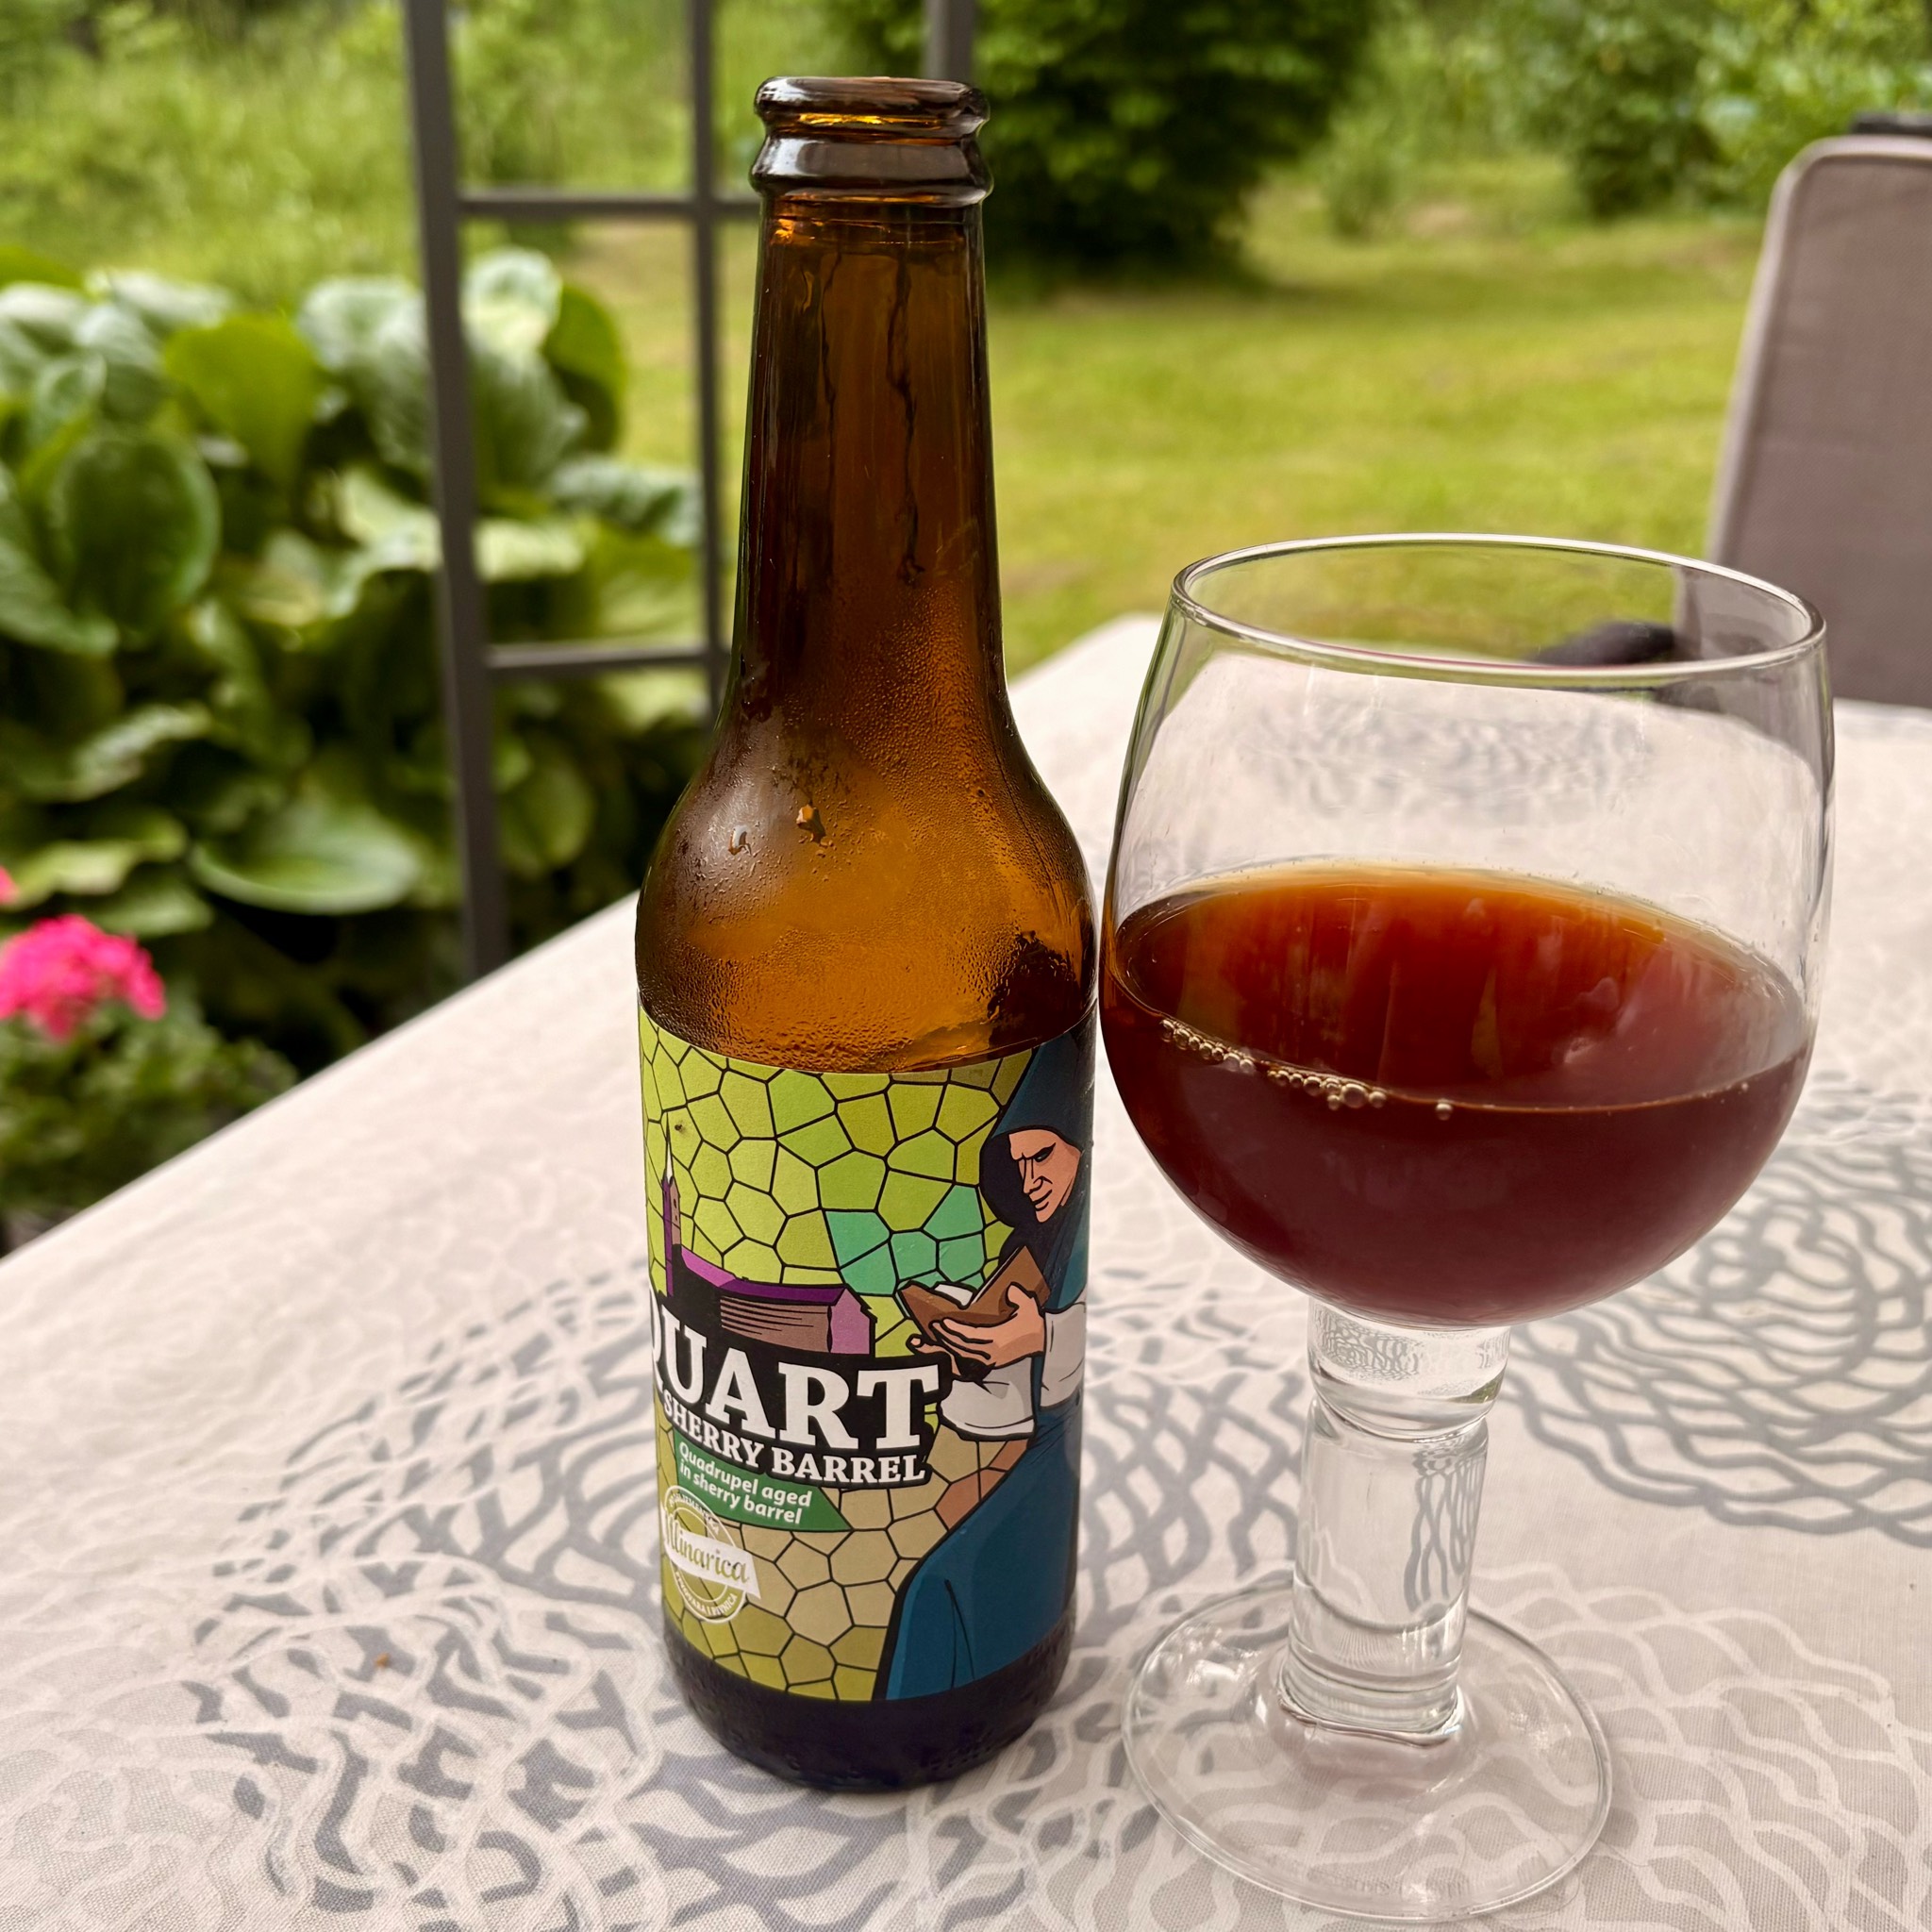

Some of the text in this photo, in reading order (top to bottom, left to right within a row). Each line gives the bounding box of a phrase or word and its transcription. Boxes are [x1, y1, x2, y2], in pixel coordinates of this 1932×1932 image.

[663, 1389, 925, 1484] SHERRY BARREL
[678, 1441, 812, 1507] Quadrupel aged
[679, 1458, 691, 1478] in
[693, 1474, 741, 1509] sherry
[743, 1497, 803, 1524] barrel
